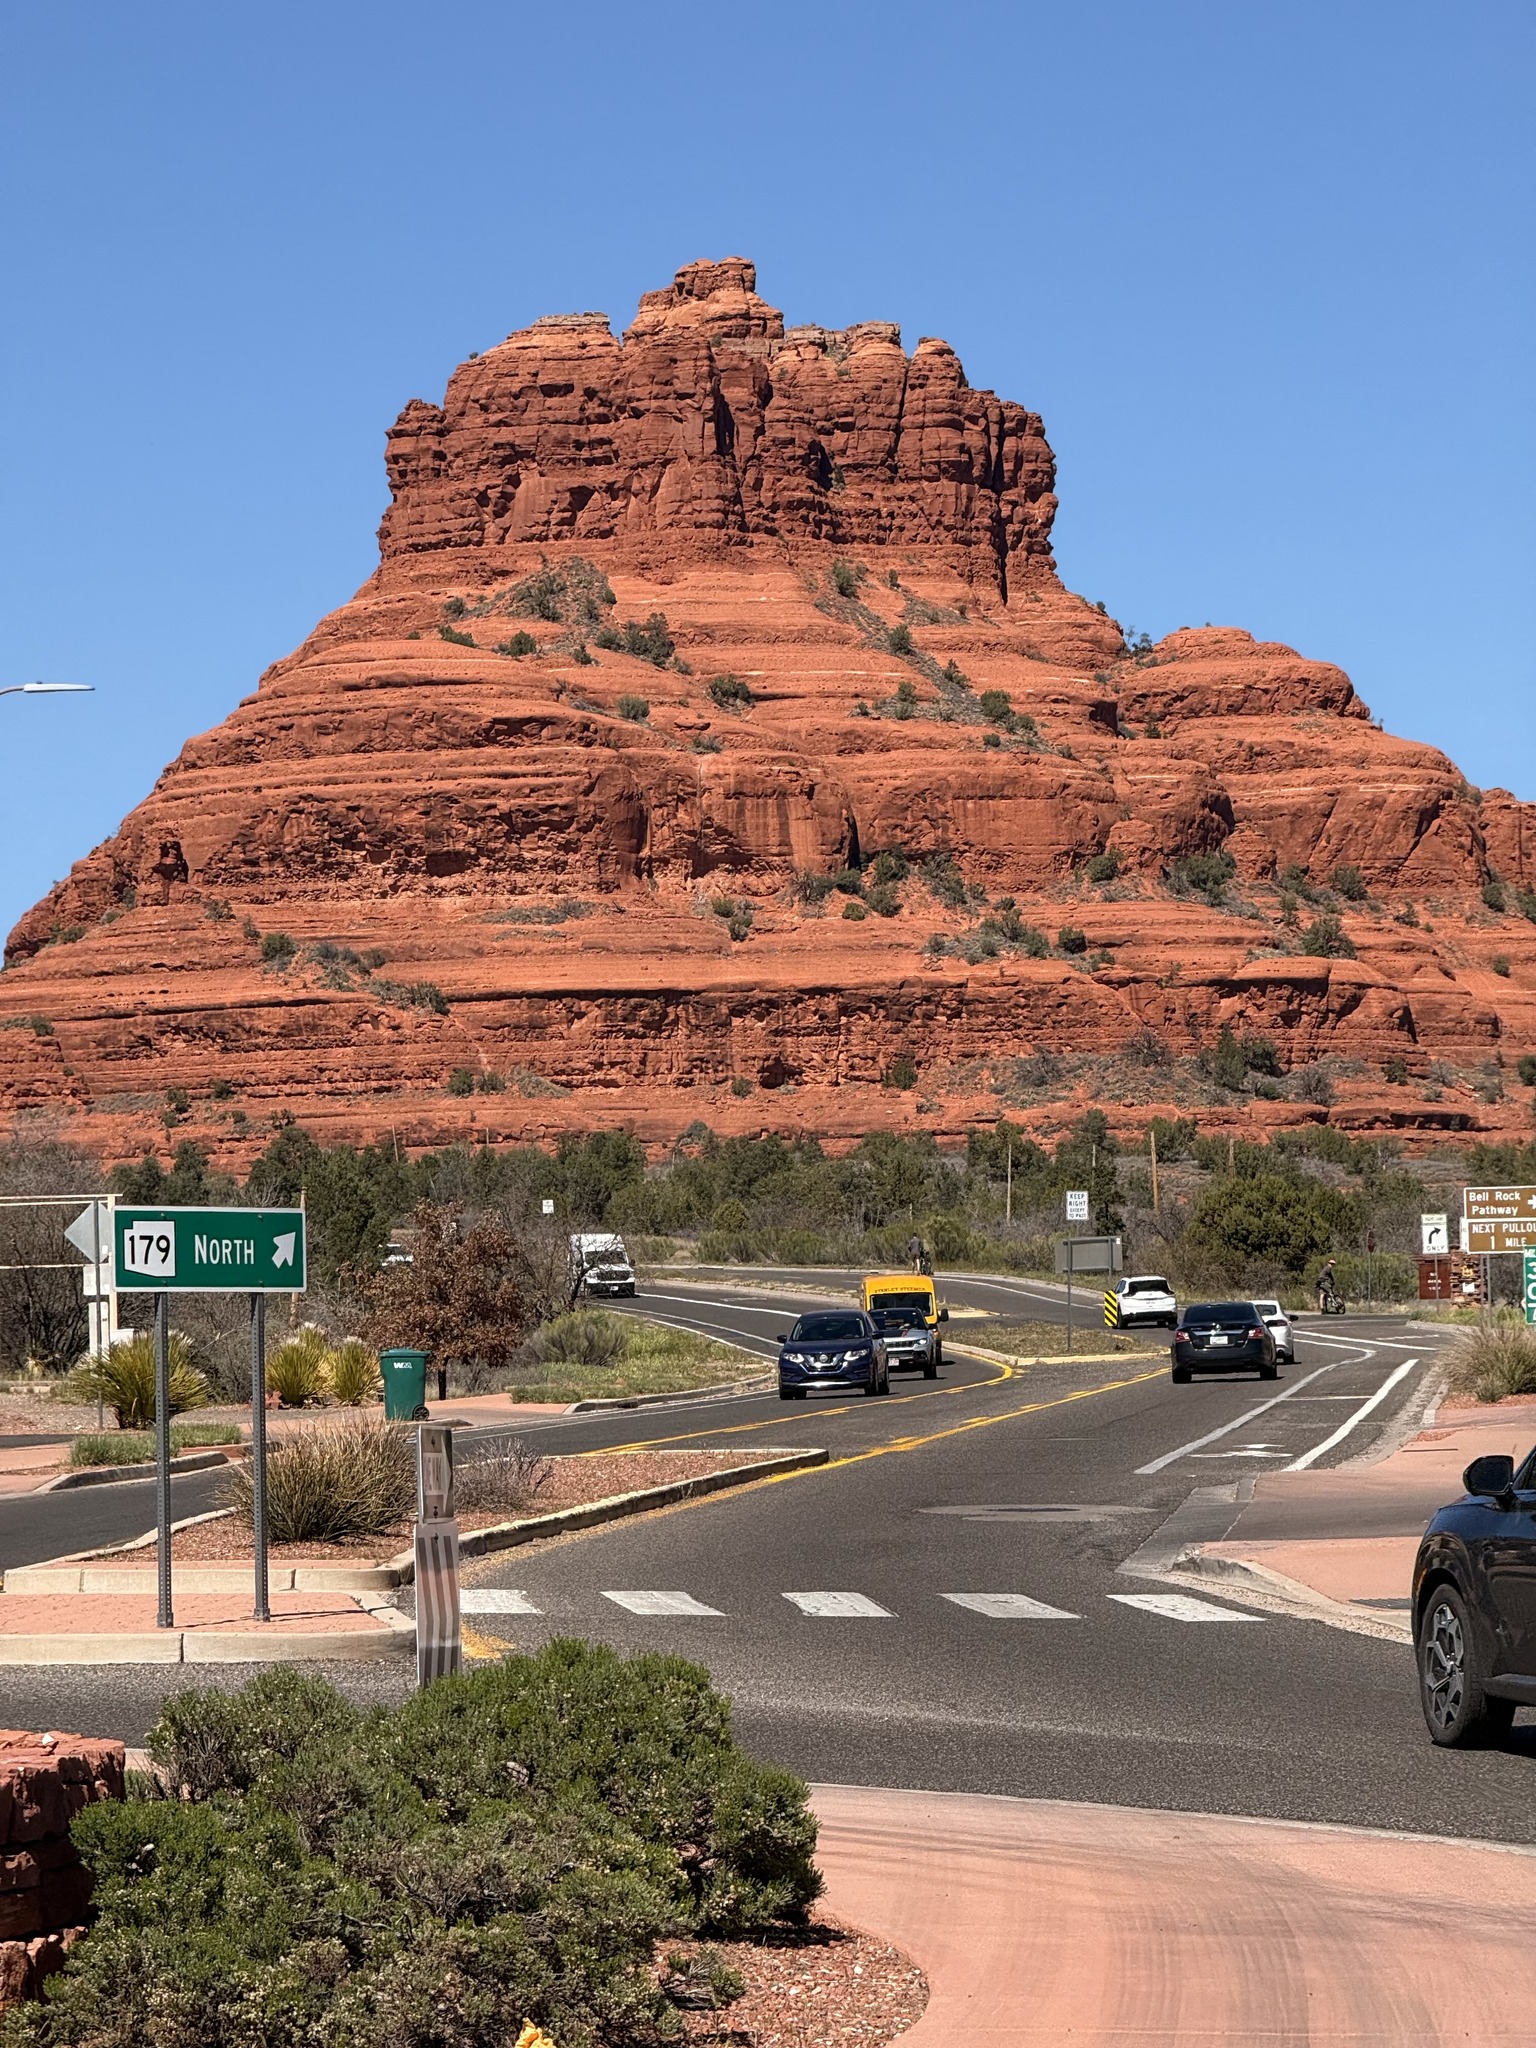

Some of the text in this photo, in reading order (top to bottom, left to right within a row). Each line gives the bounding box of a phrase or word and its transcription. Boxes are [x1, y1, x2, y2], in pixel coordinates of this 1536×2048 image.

[1469, 1191, 1521, 1201] Bell Rock
[1471, 1205, 1518, 1216] Pathway
[1472, 1223, 1496, 1234] NEXT
[1490, 1235, 1527, 1250] 1 MILE
[128, 1234, 171, 1265] 179
